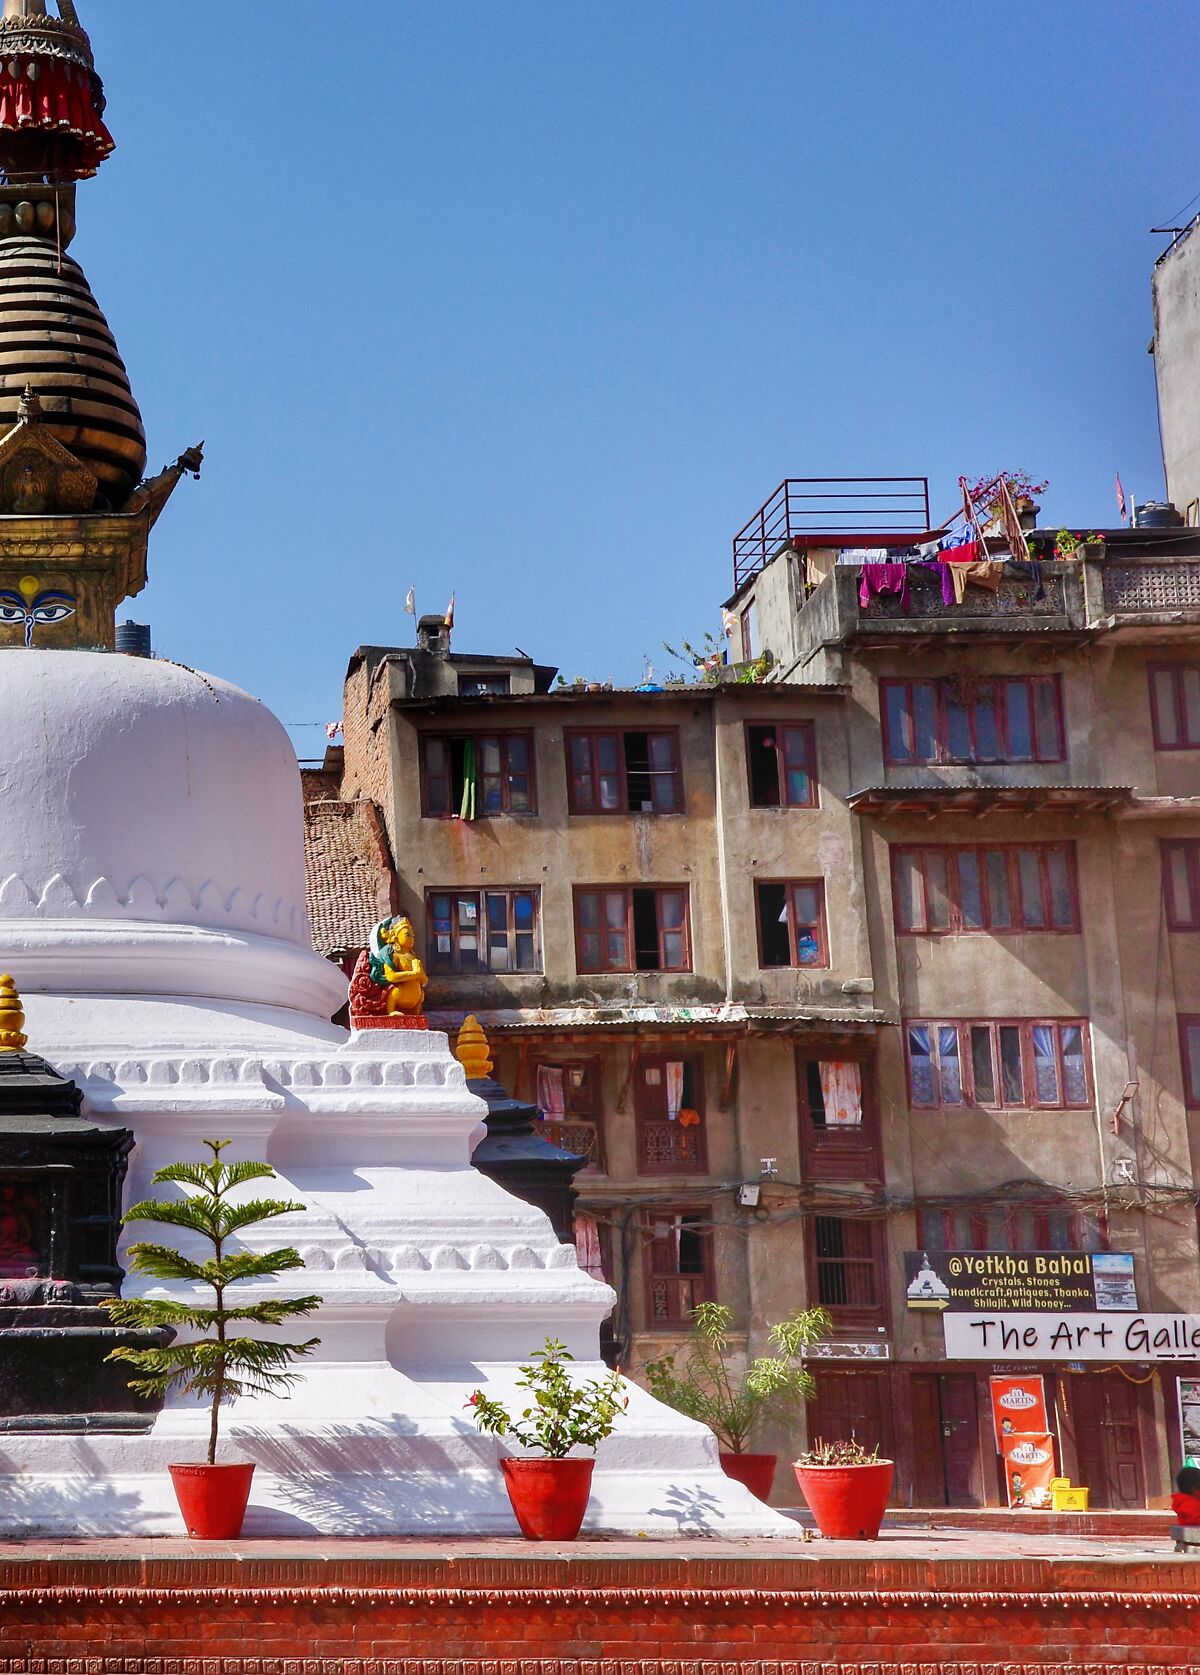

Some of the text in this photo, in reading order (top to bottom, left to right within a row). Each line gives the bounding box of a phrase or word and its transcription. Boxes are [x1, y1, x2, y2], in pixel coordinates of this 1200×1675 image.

[948, 1254, 1091, 1276] @Yetkha Bahal
[1026, 1277, 1060, 1286] Stones
[1011, 1299, 1032, 1308] Wild
[969, 1320, 1038, 1351] The
[1050, 1321, 1113, 1350] Art
[1001, 1397, 1035, 1405] MARTIN
[1012, 1451, 1046, 1460] MARTIN
